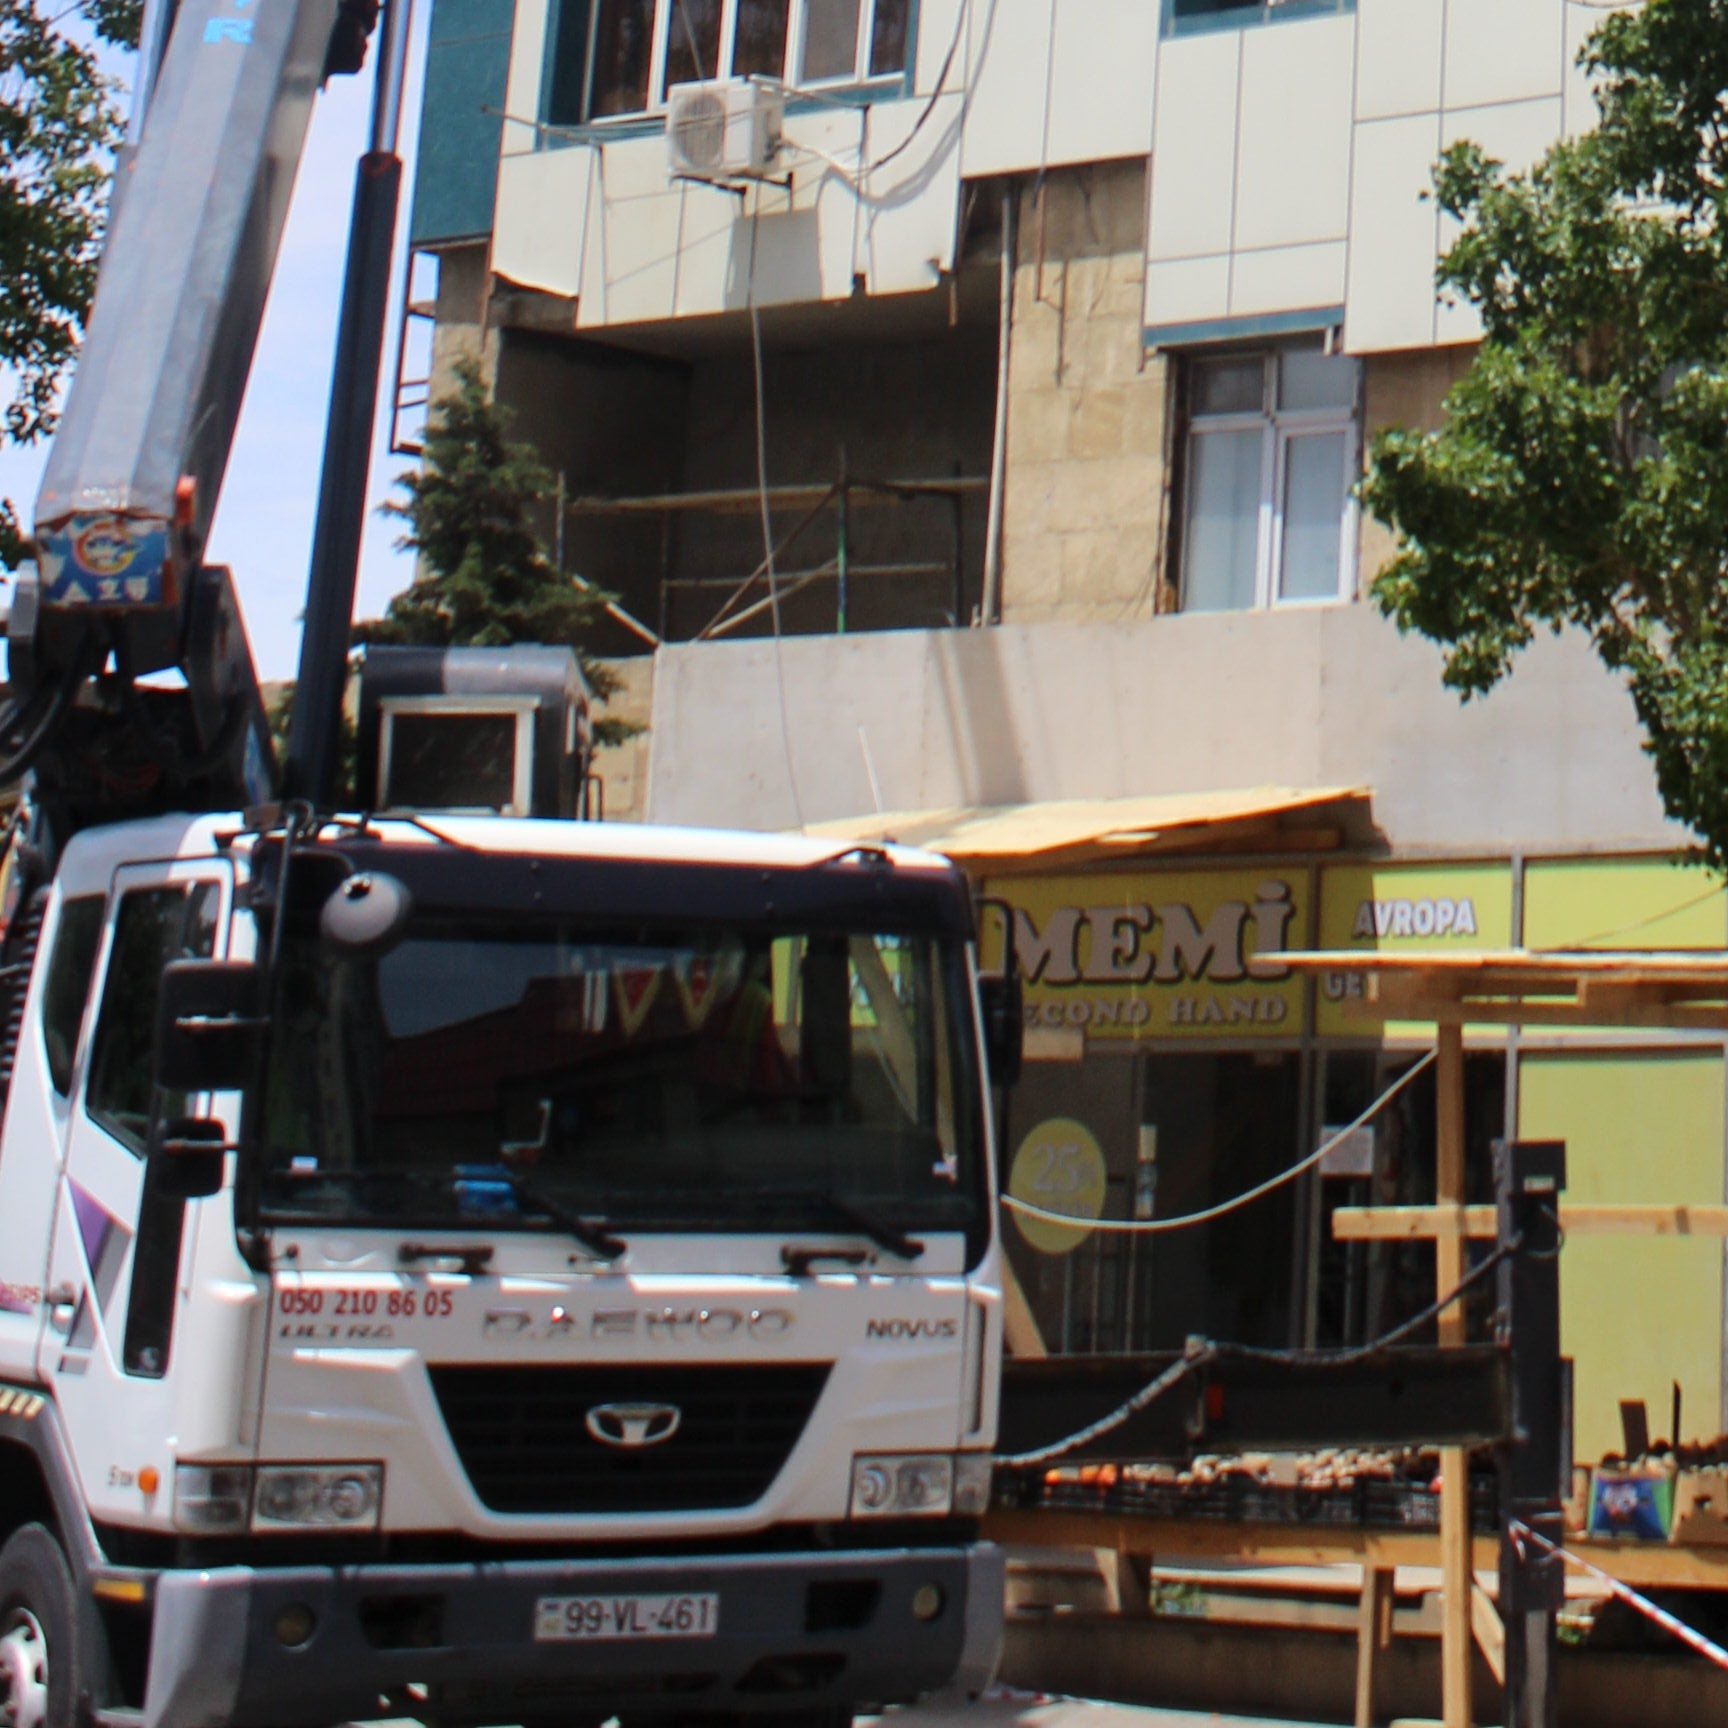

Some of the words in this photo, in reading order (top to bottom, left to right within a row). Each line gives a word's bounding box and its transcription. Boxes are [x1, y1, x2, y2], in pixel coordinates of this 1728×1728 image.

[1354, 898, 1477, 937] AVROPA
[1022, 997, 1150, 1025] ECOND
[1168, 995, 1287, 1024] HAND
[279, 1289, 323, 1314] 050
[334, 1289, 377, 1315] 210
[387, 1290, 417, 1316] 86
[424, 1291, 454, 1317] 05
[482, 1307, 795, 1340] DAEWOO
[866, 1318, 958, 1339] NOVUS
